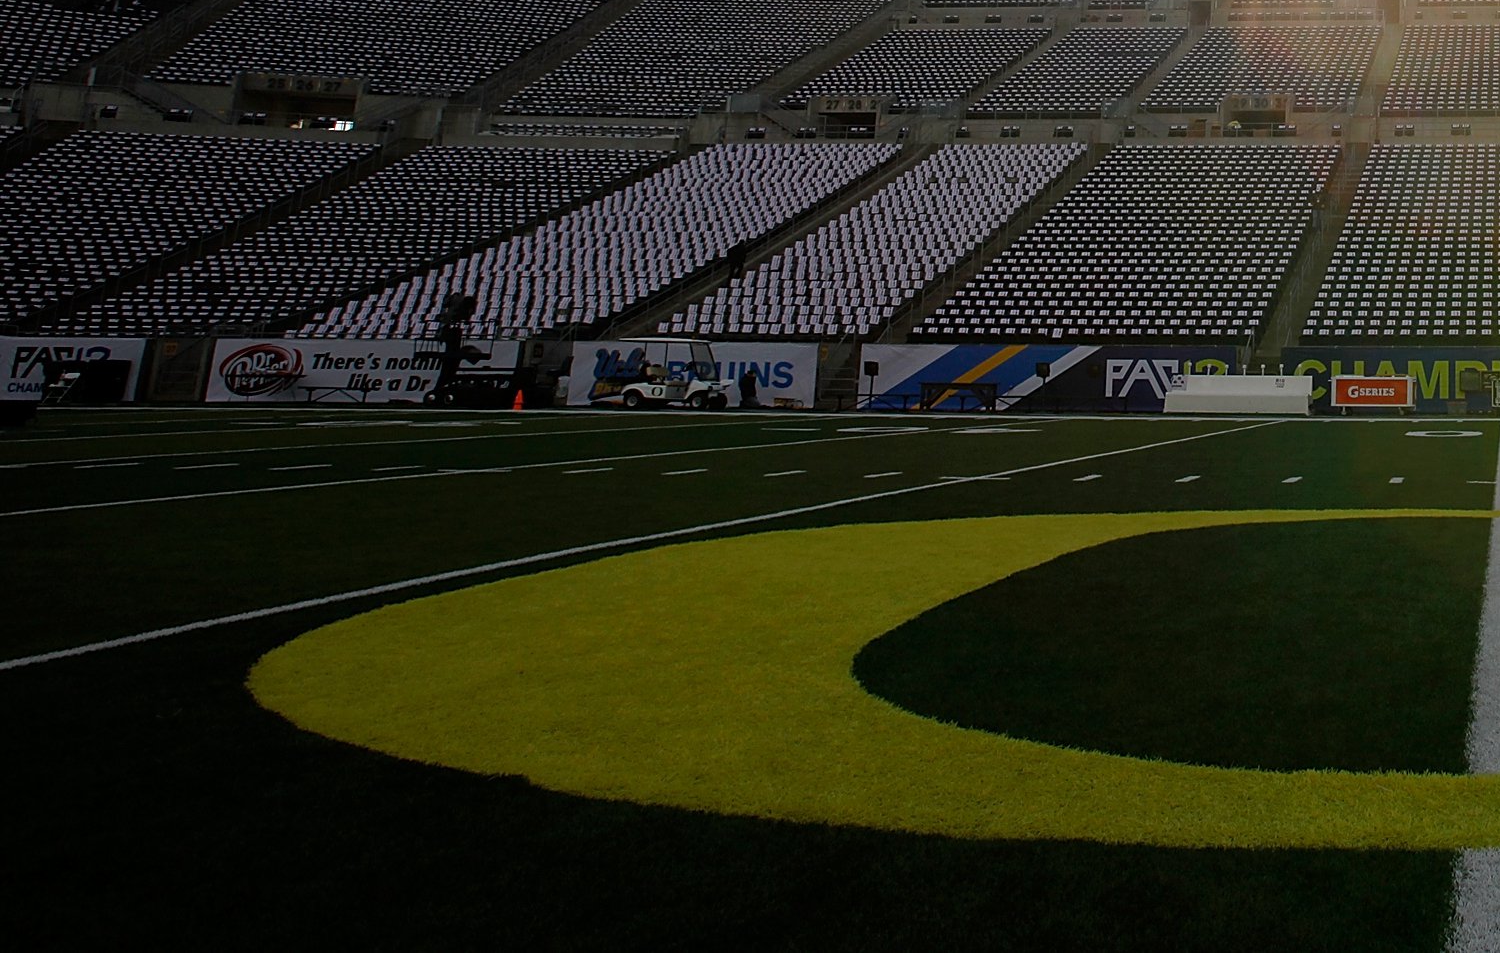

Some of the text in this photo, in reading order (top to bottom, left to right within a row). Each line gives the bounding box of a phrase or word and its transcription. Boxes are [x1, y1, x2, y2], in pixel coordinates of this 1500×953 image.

[312, 352, 381, 370] There's
[347, 373, 431, 392] like a Dr
[1359, 387, 1395, 397] SERIES
